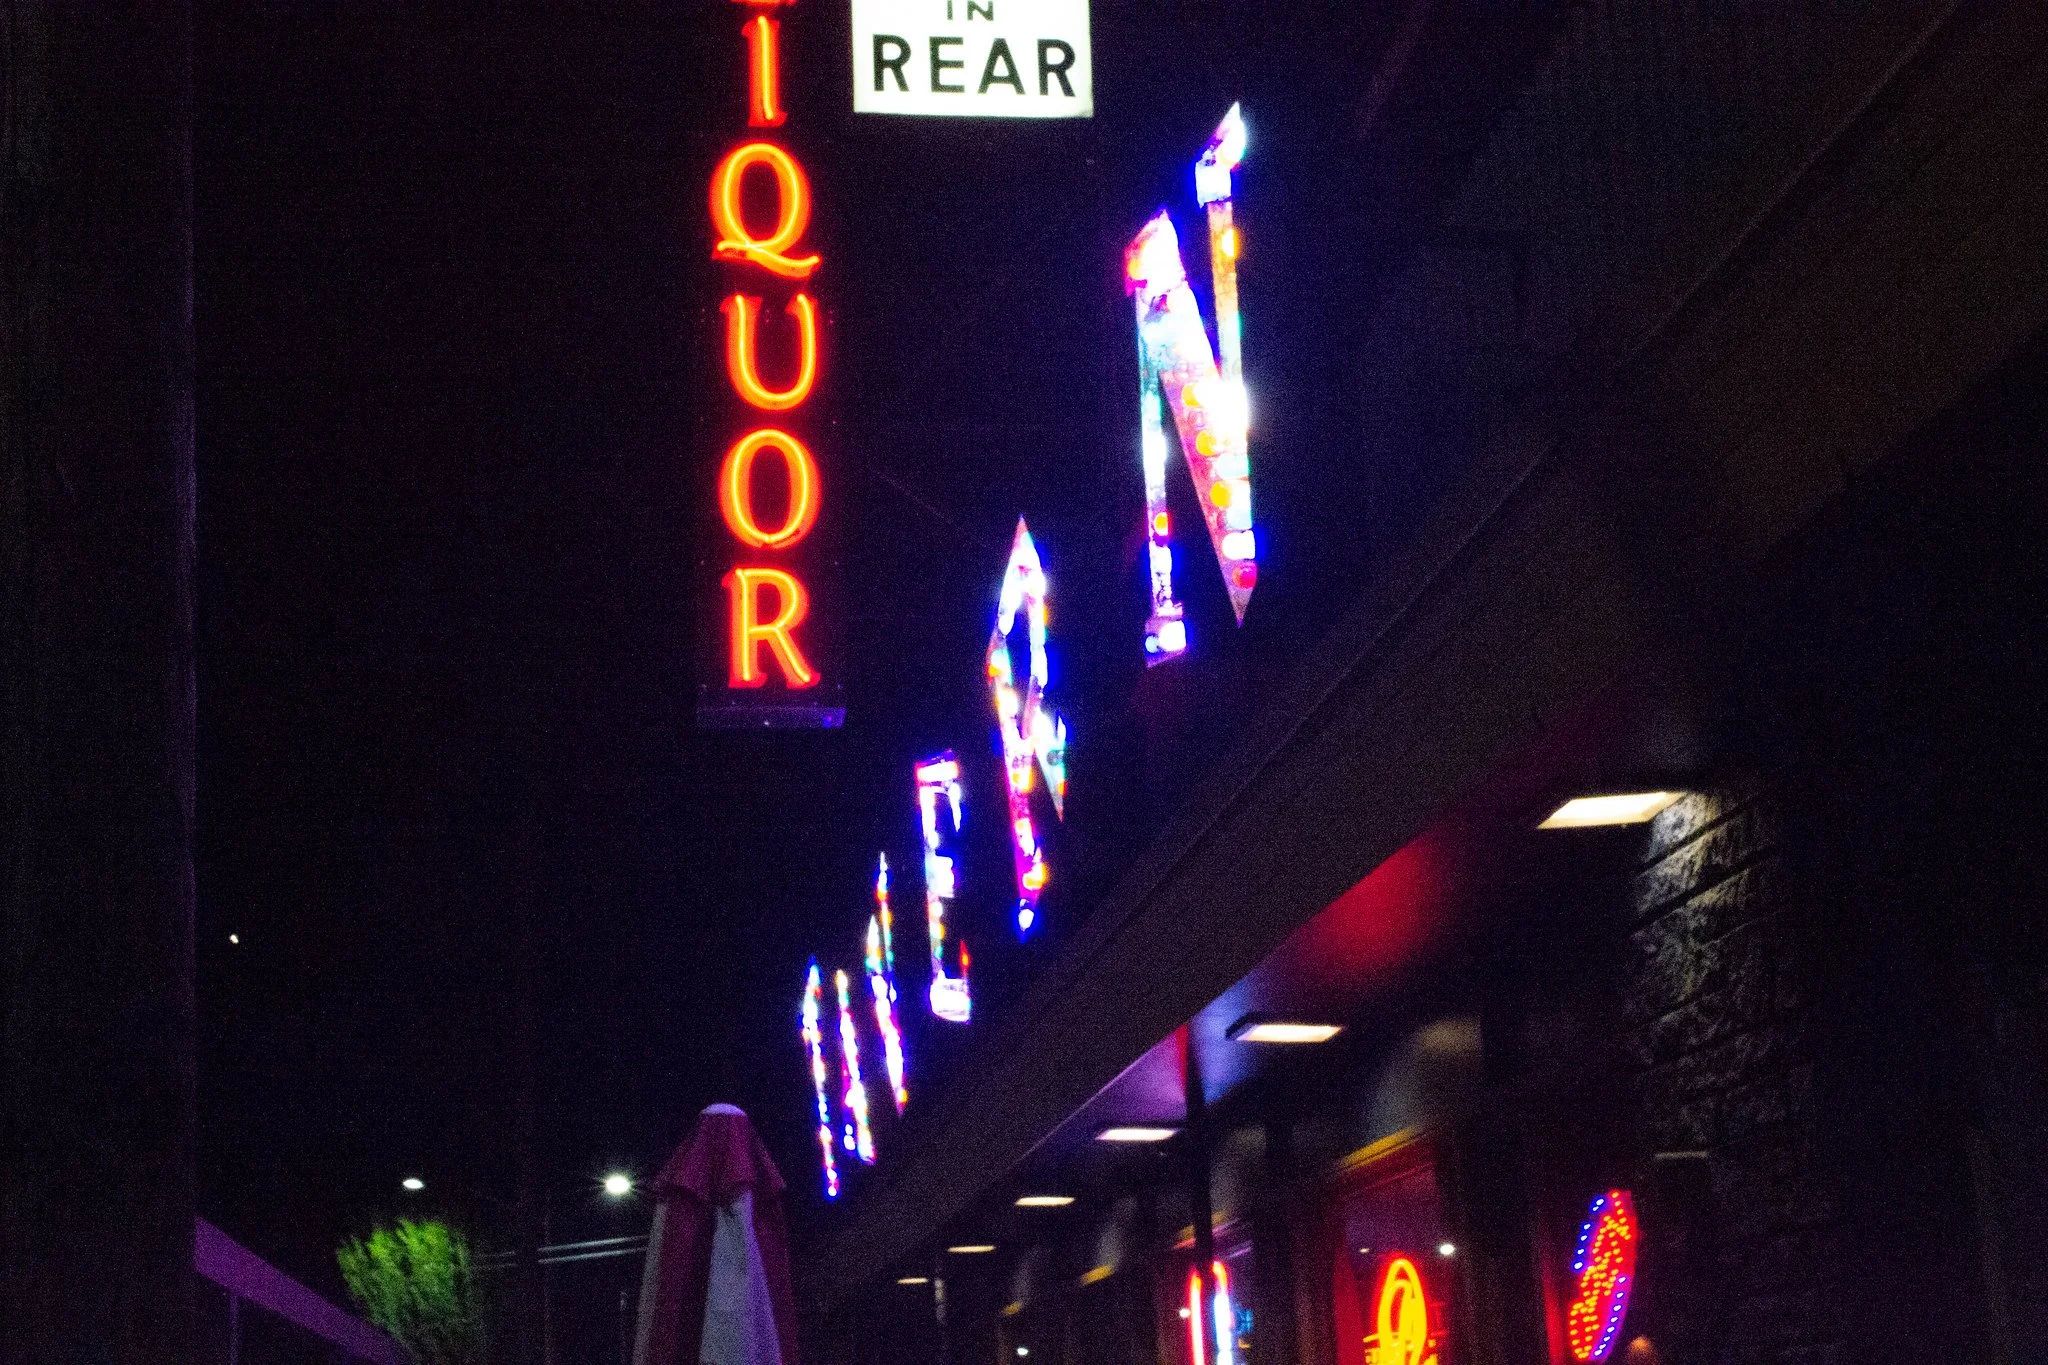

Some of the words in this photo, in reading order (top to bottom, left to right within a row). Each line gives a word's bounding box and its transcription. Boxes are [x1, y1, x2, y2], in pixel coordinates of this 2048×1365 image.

[946, 0, 994, 21] IN
[871, 33, 1077, 98] REAR
[709, 0, 821, 689] IQUOR
